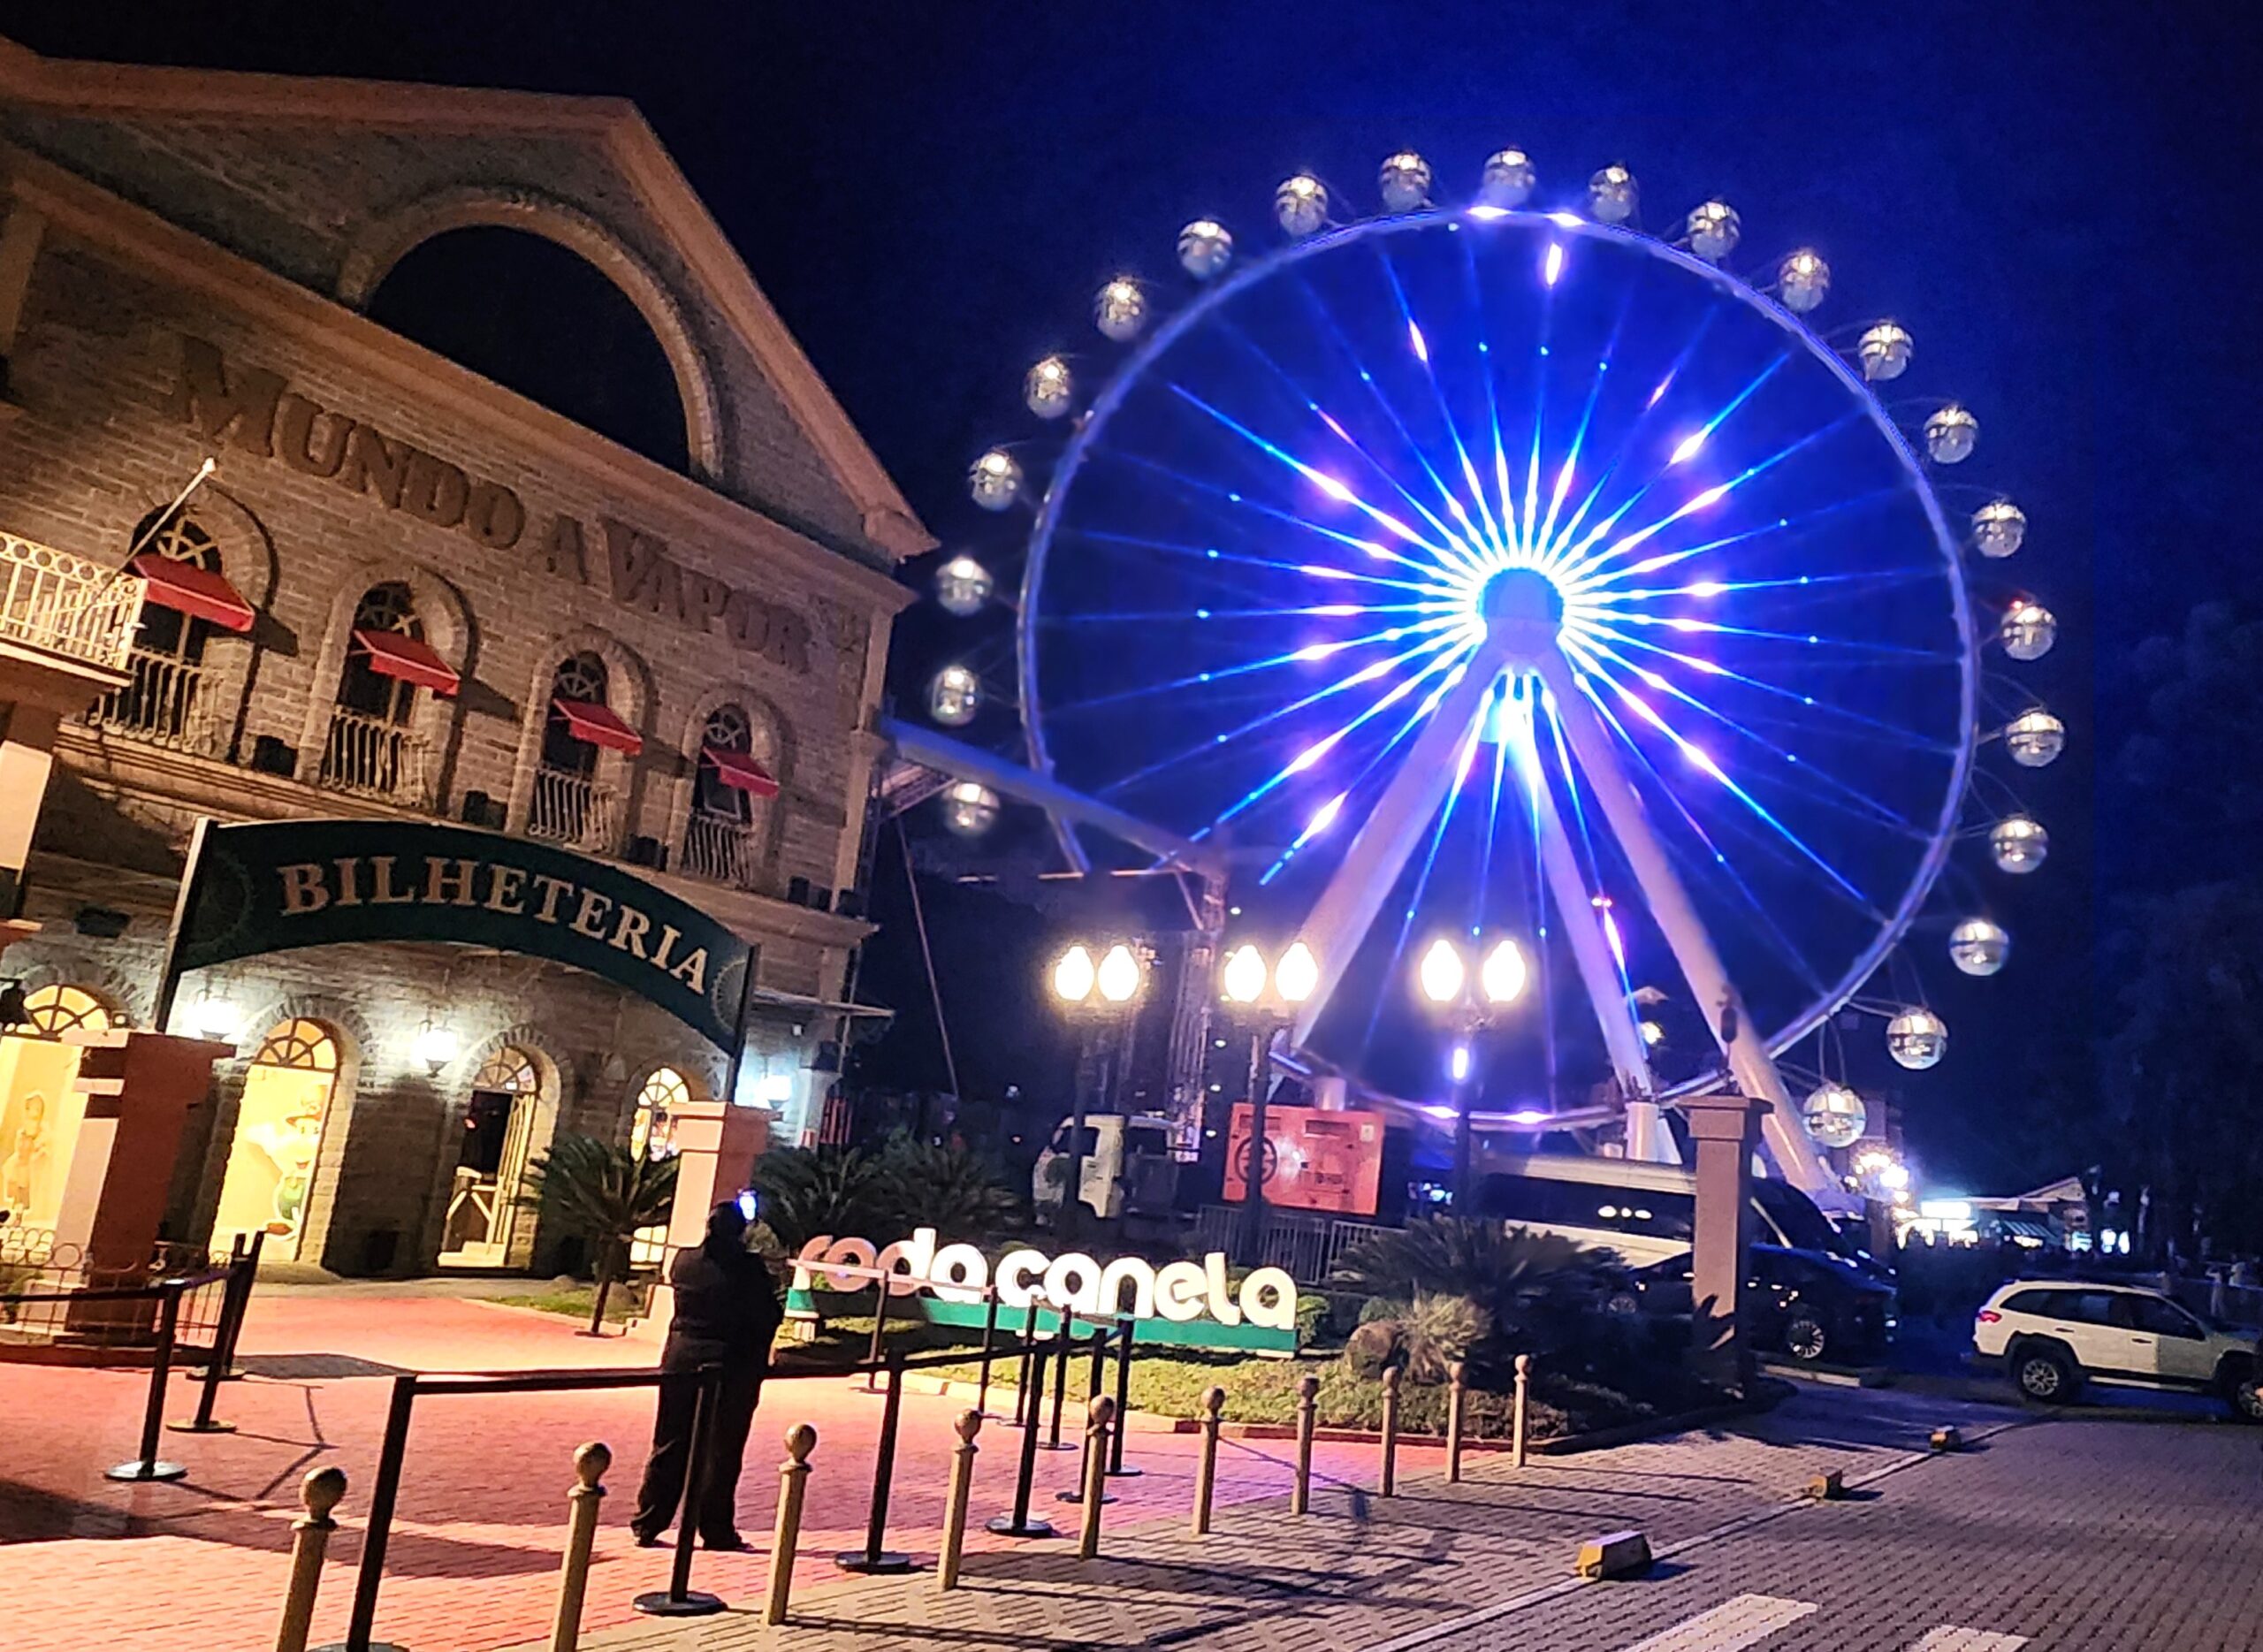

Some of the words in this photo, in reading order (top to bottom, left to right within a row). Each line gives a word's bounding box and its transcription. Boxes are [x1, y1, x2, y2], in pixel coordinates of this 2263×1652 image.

[177, 333, 527, 551] MUNDO
[541, 513, 590, 587] A
[598, 513, 813, 675] VAPOR
[277, 856, 709, 995] BILHETERIA
[792, 1227, 989, 1305] roda
[994, 1248, 1298, 1329] canela
